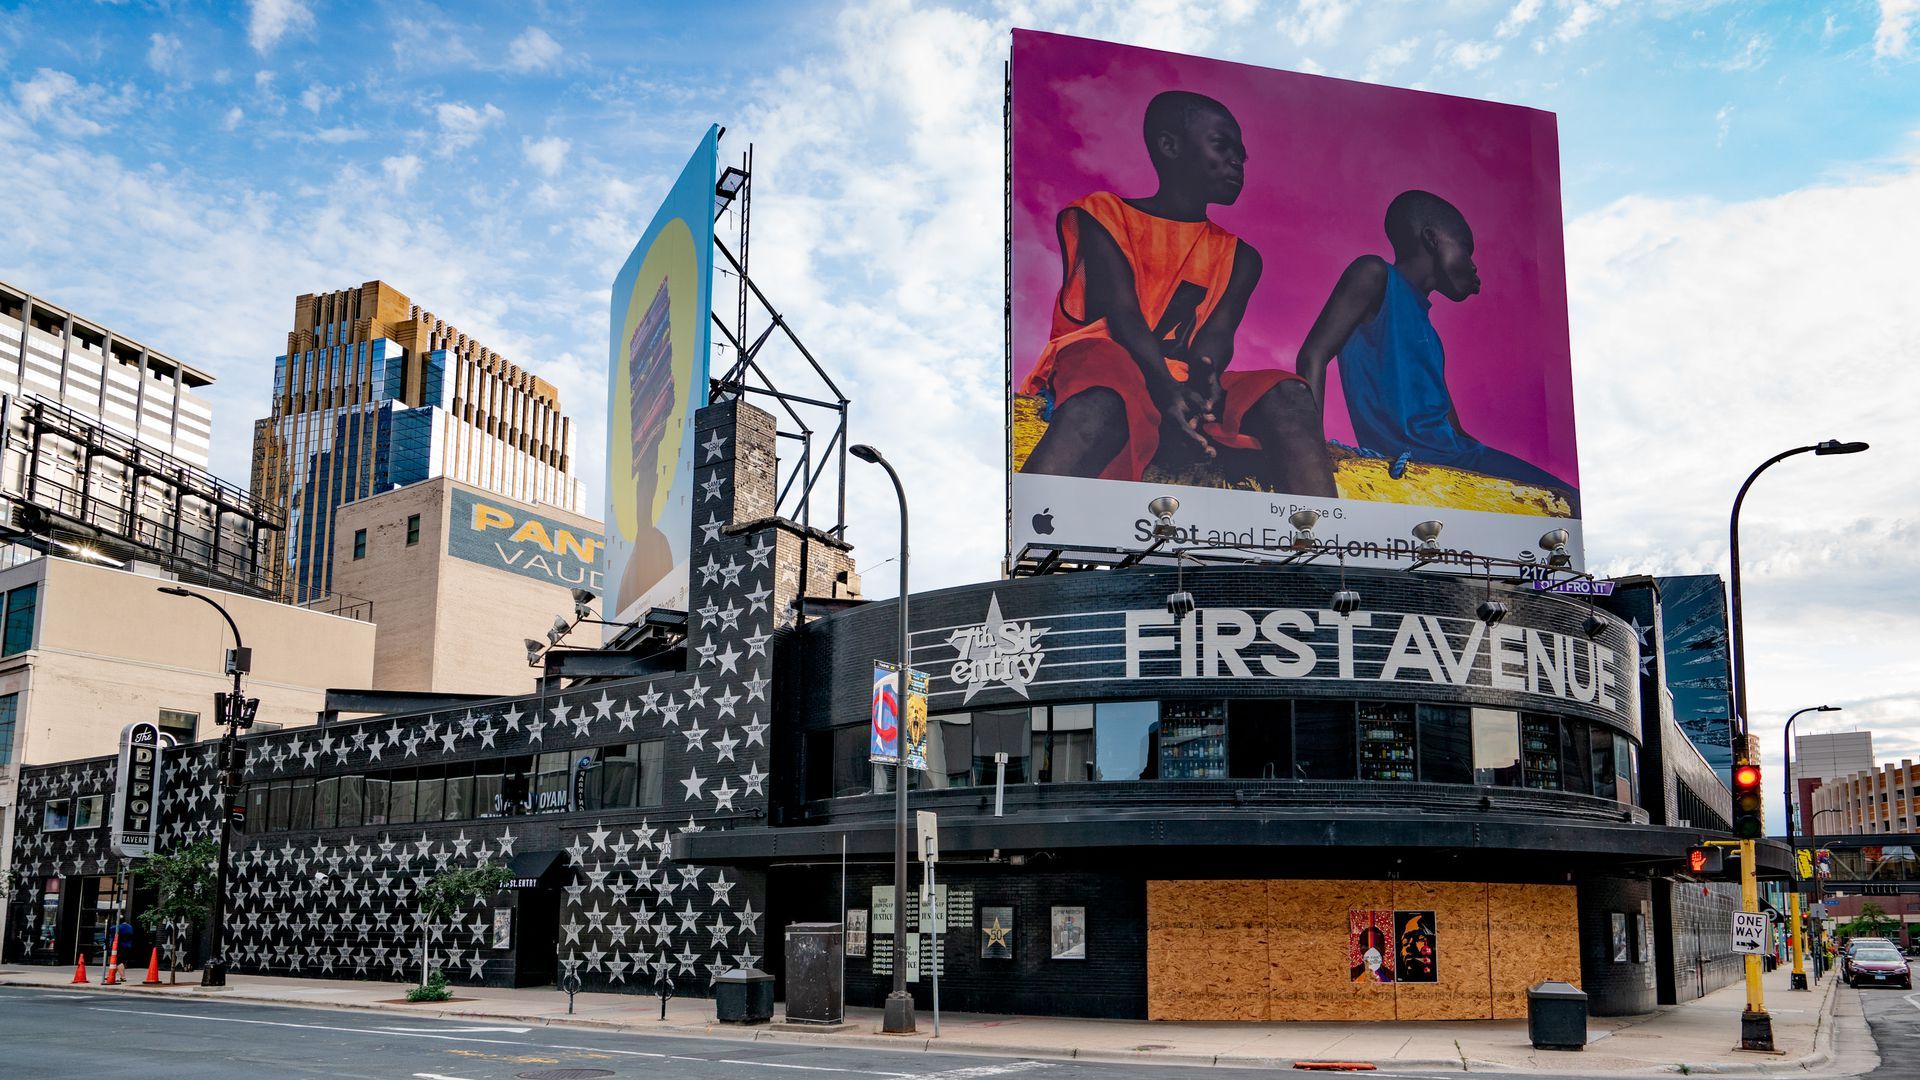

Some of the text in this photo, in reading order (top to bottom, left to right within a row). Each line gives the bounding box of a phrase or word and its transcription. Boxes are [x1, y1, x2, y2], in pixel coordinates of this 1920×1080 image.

[1270, 503, 1286, 516] by
[1333, 507, 1347, 520] G.
[1207, 527, 1254, 549] and
[1347, 539, 1378, 559] on
[950, 622, 1042, 660] 7th St
[951, 651, 1045, 684] entry
[1125, 608, 1616, 711] FIRST AVENUE
[135, 726, 153, 743] The
[130, 747, 153, 831] DEPOT
[122, 834, 149, 845] TAVERN
[1737, 914, 1763, 927] ONE
[990, 930, 1003, 941] 50
[1736, 926, 1763, 938] WAY
